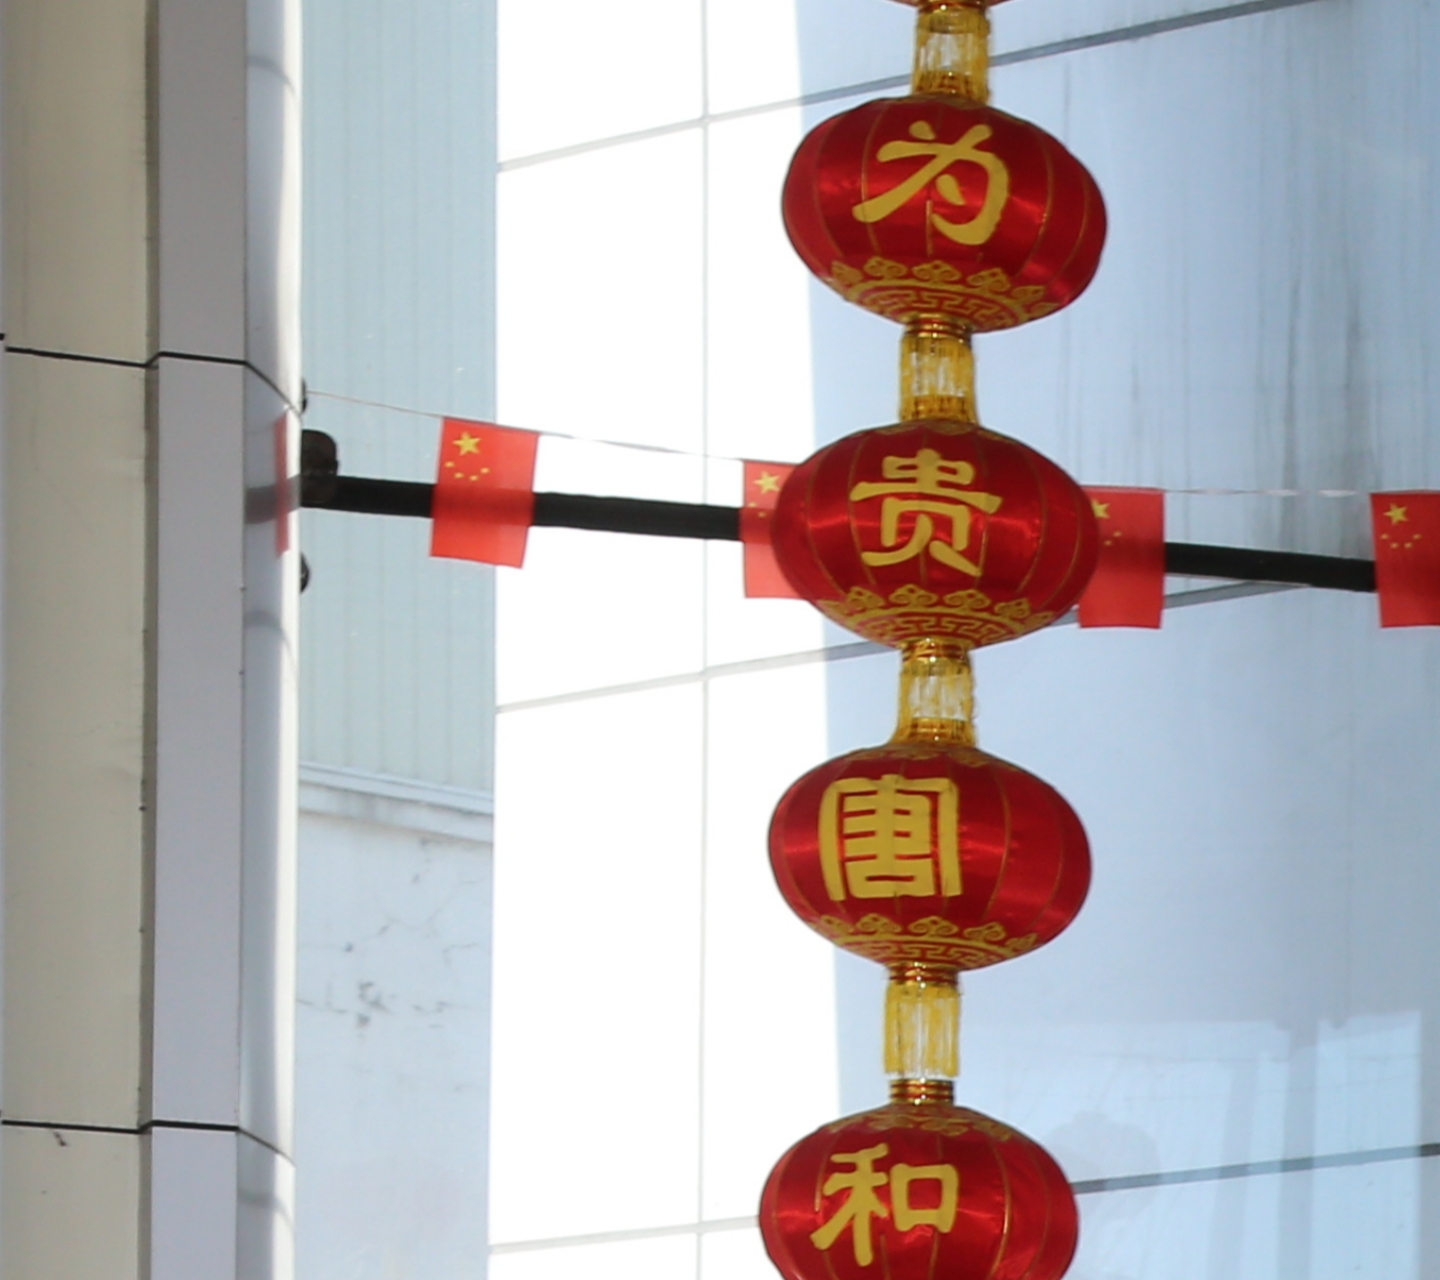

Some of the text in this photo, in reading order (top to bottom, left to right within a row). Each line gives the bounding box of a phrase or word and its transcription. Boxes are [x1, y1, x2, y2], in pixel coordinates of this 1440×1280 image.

[853, 122, 1009, 246] 为
[849, 449, 1002, 577] 贵
[810, 1143, 959, 1267] 和
